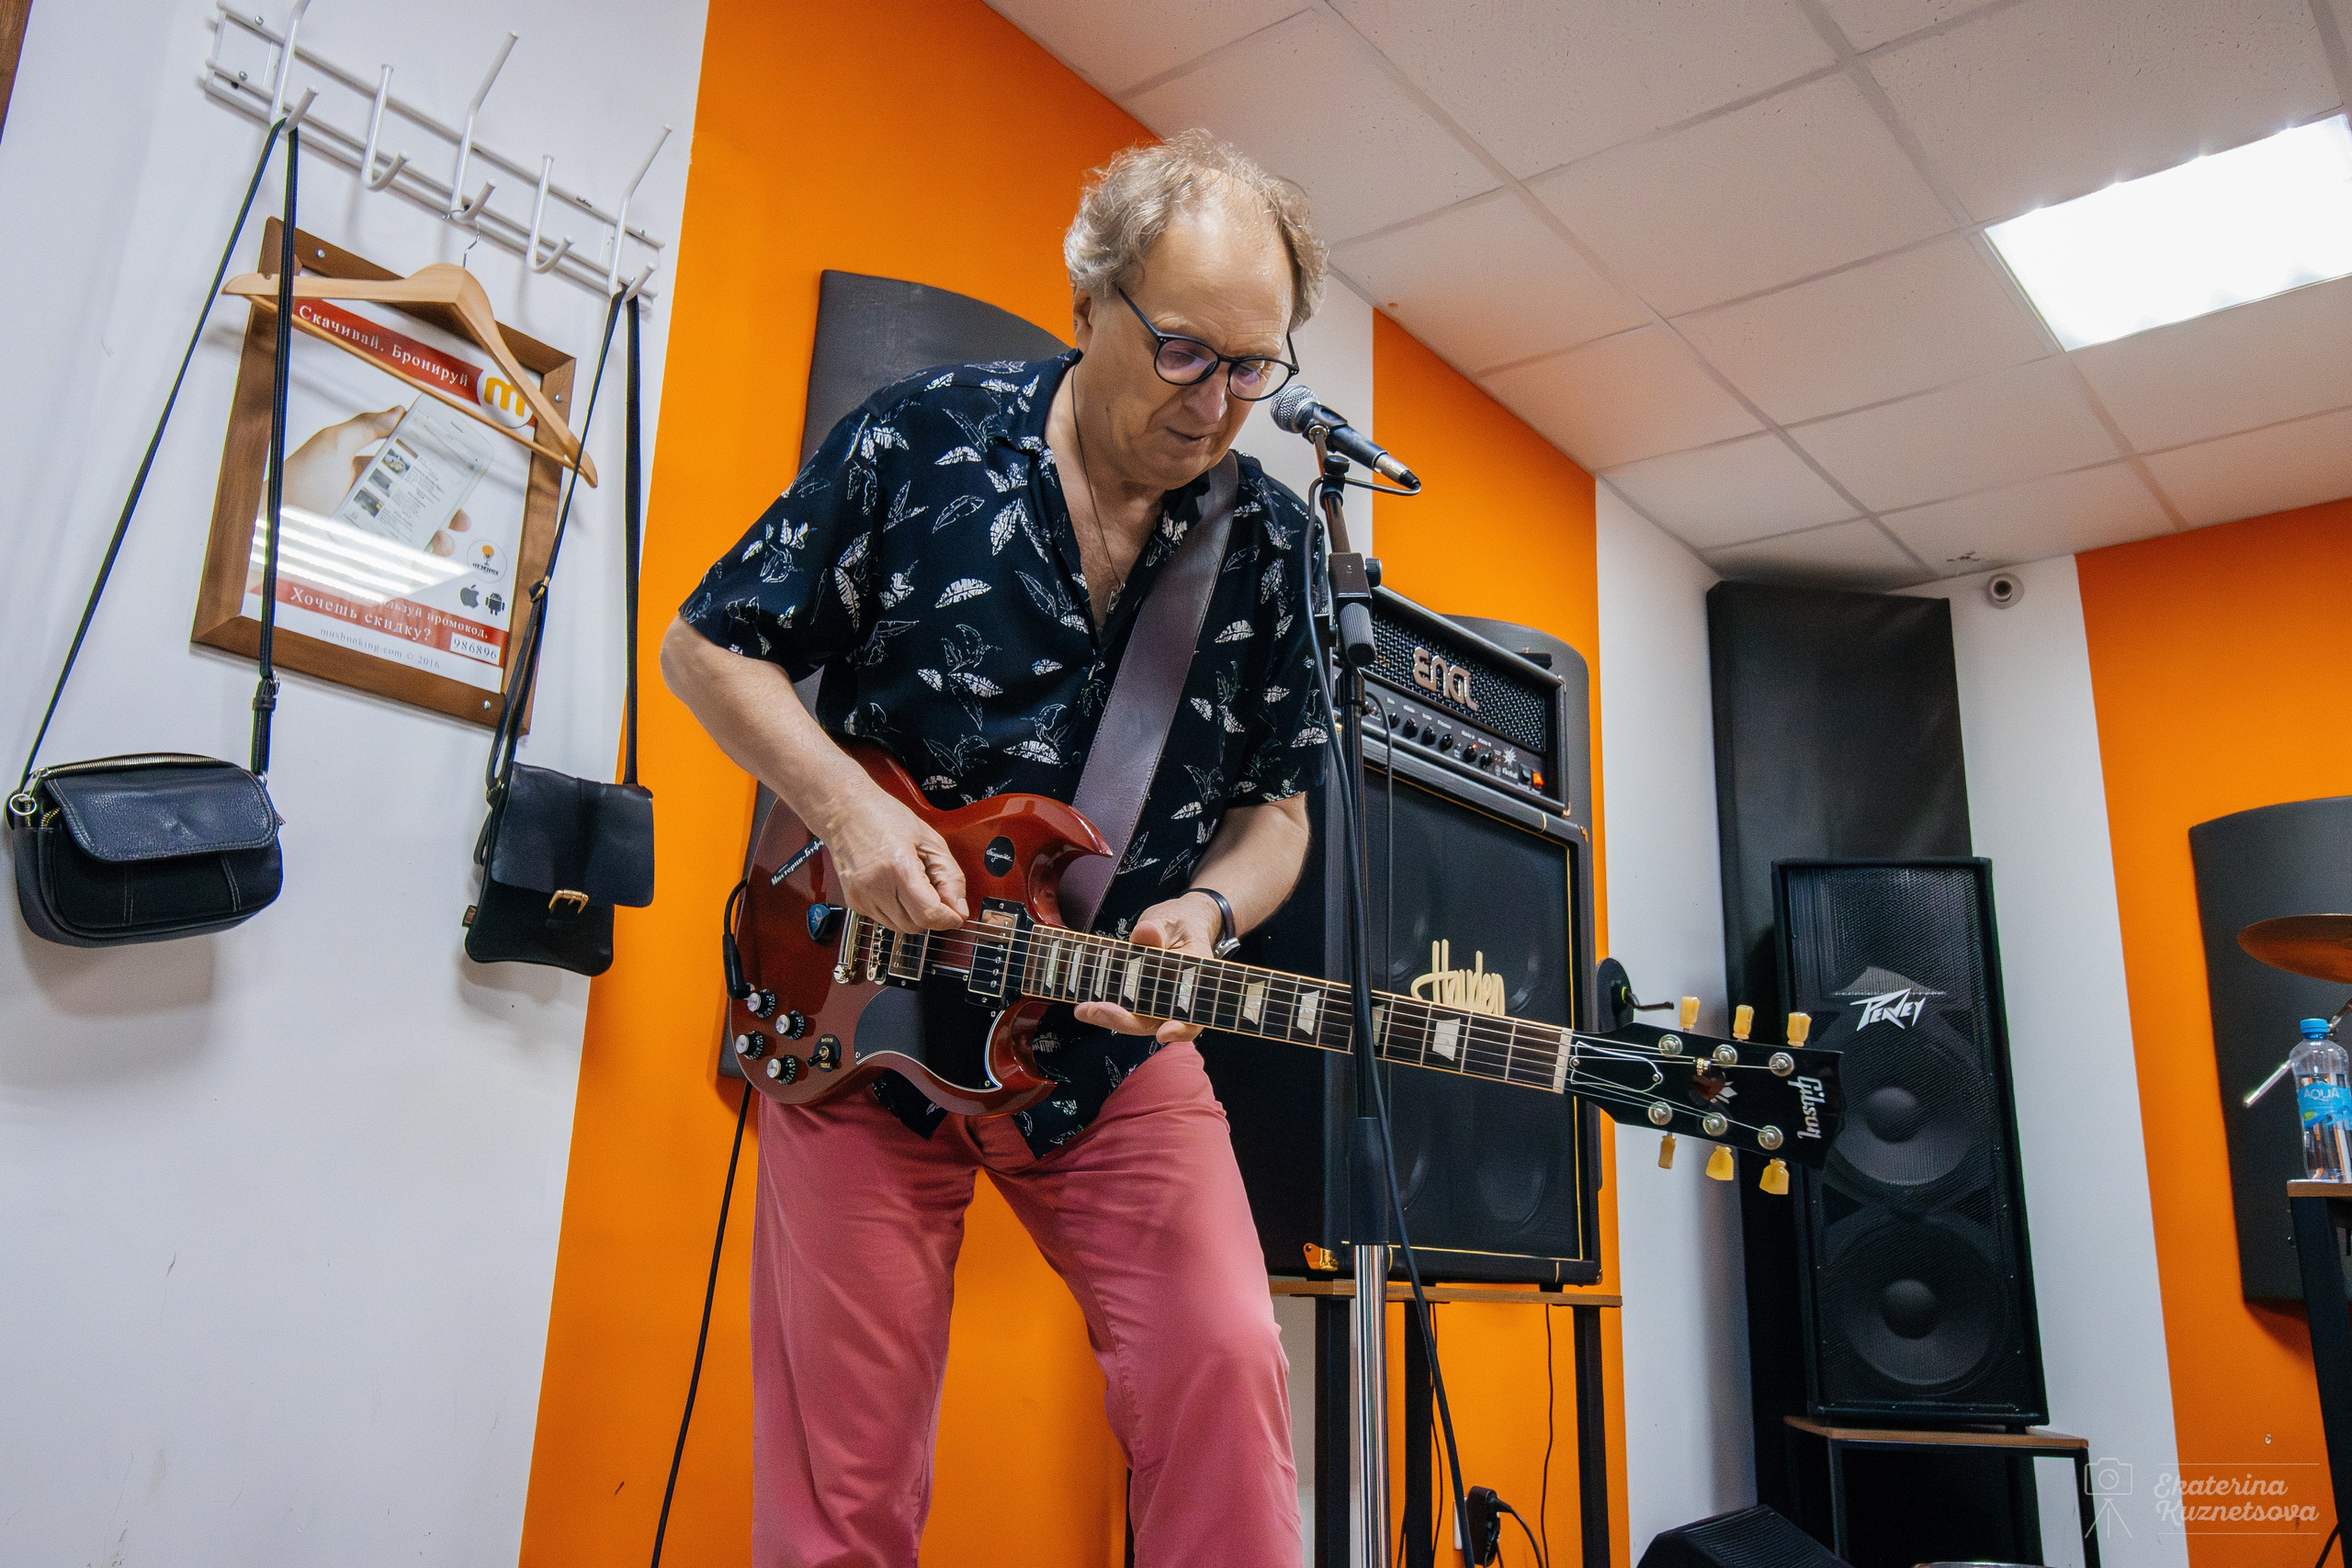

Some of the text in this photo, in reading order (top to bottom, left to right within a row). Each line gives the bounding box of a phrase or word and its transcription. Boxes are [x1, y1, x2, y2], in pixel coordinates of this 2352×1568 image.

[299, 305, 469, 387] Скачивай. Бронируй
[290, 587, 432, 642] Хочешь скидку?
[427, 612, 488, 639] промокод,
[320, 628, 402, 659] musbooking.com
[417, 656, 440, 669] 2016
[453, 637, 497, 660] 986896
[1413, 647, 1478, 711] ENGL
[1787, 1076, 1826, 1139] Gibson
[2303, 1088, 2340, 1100] AQUA
